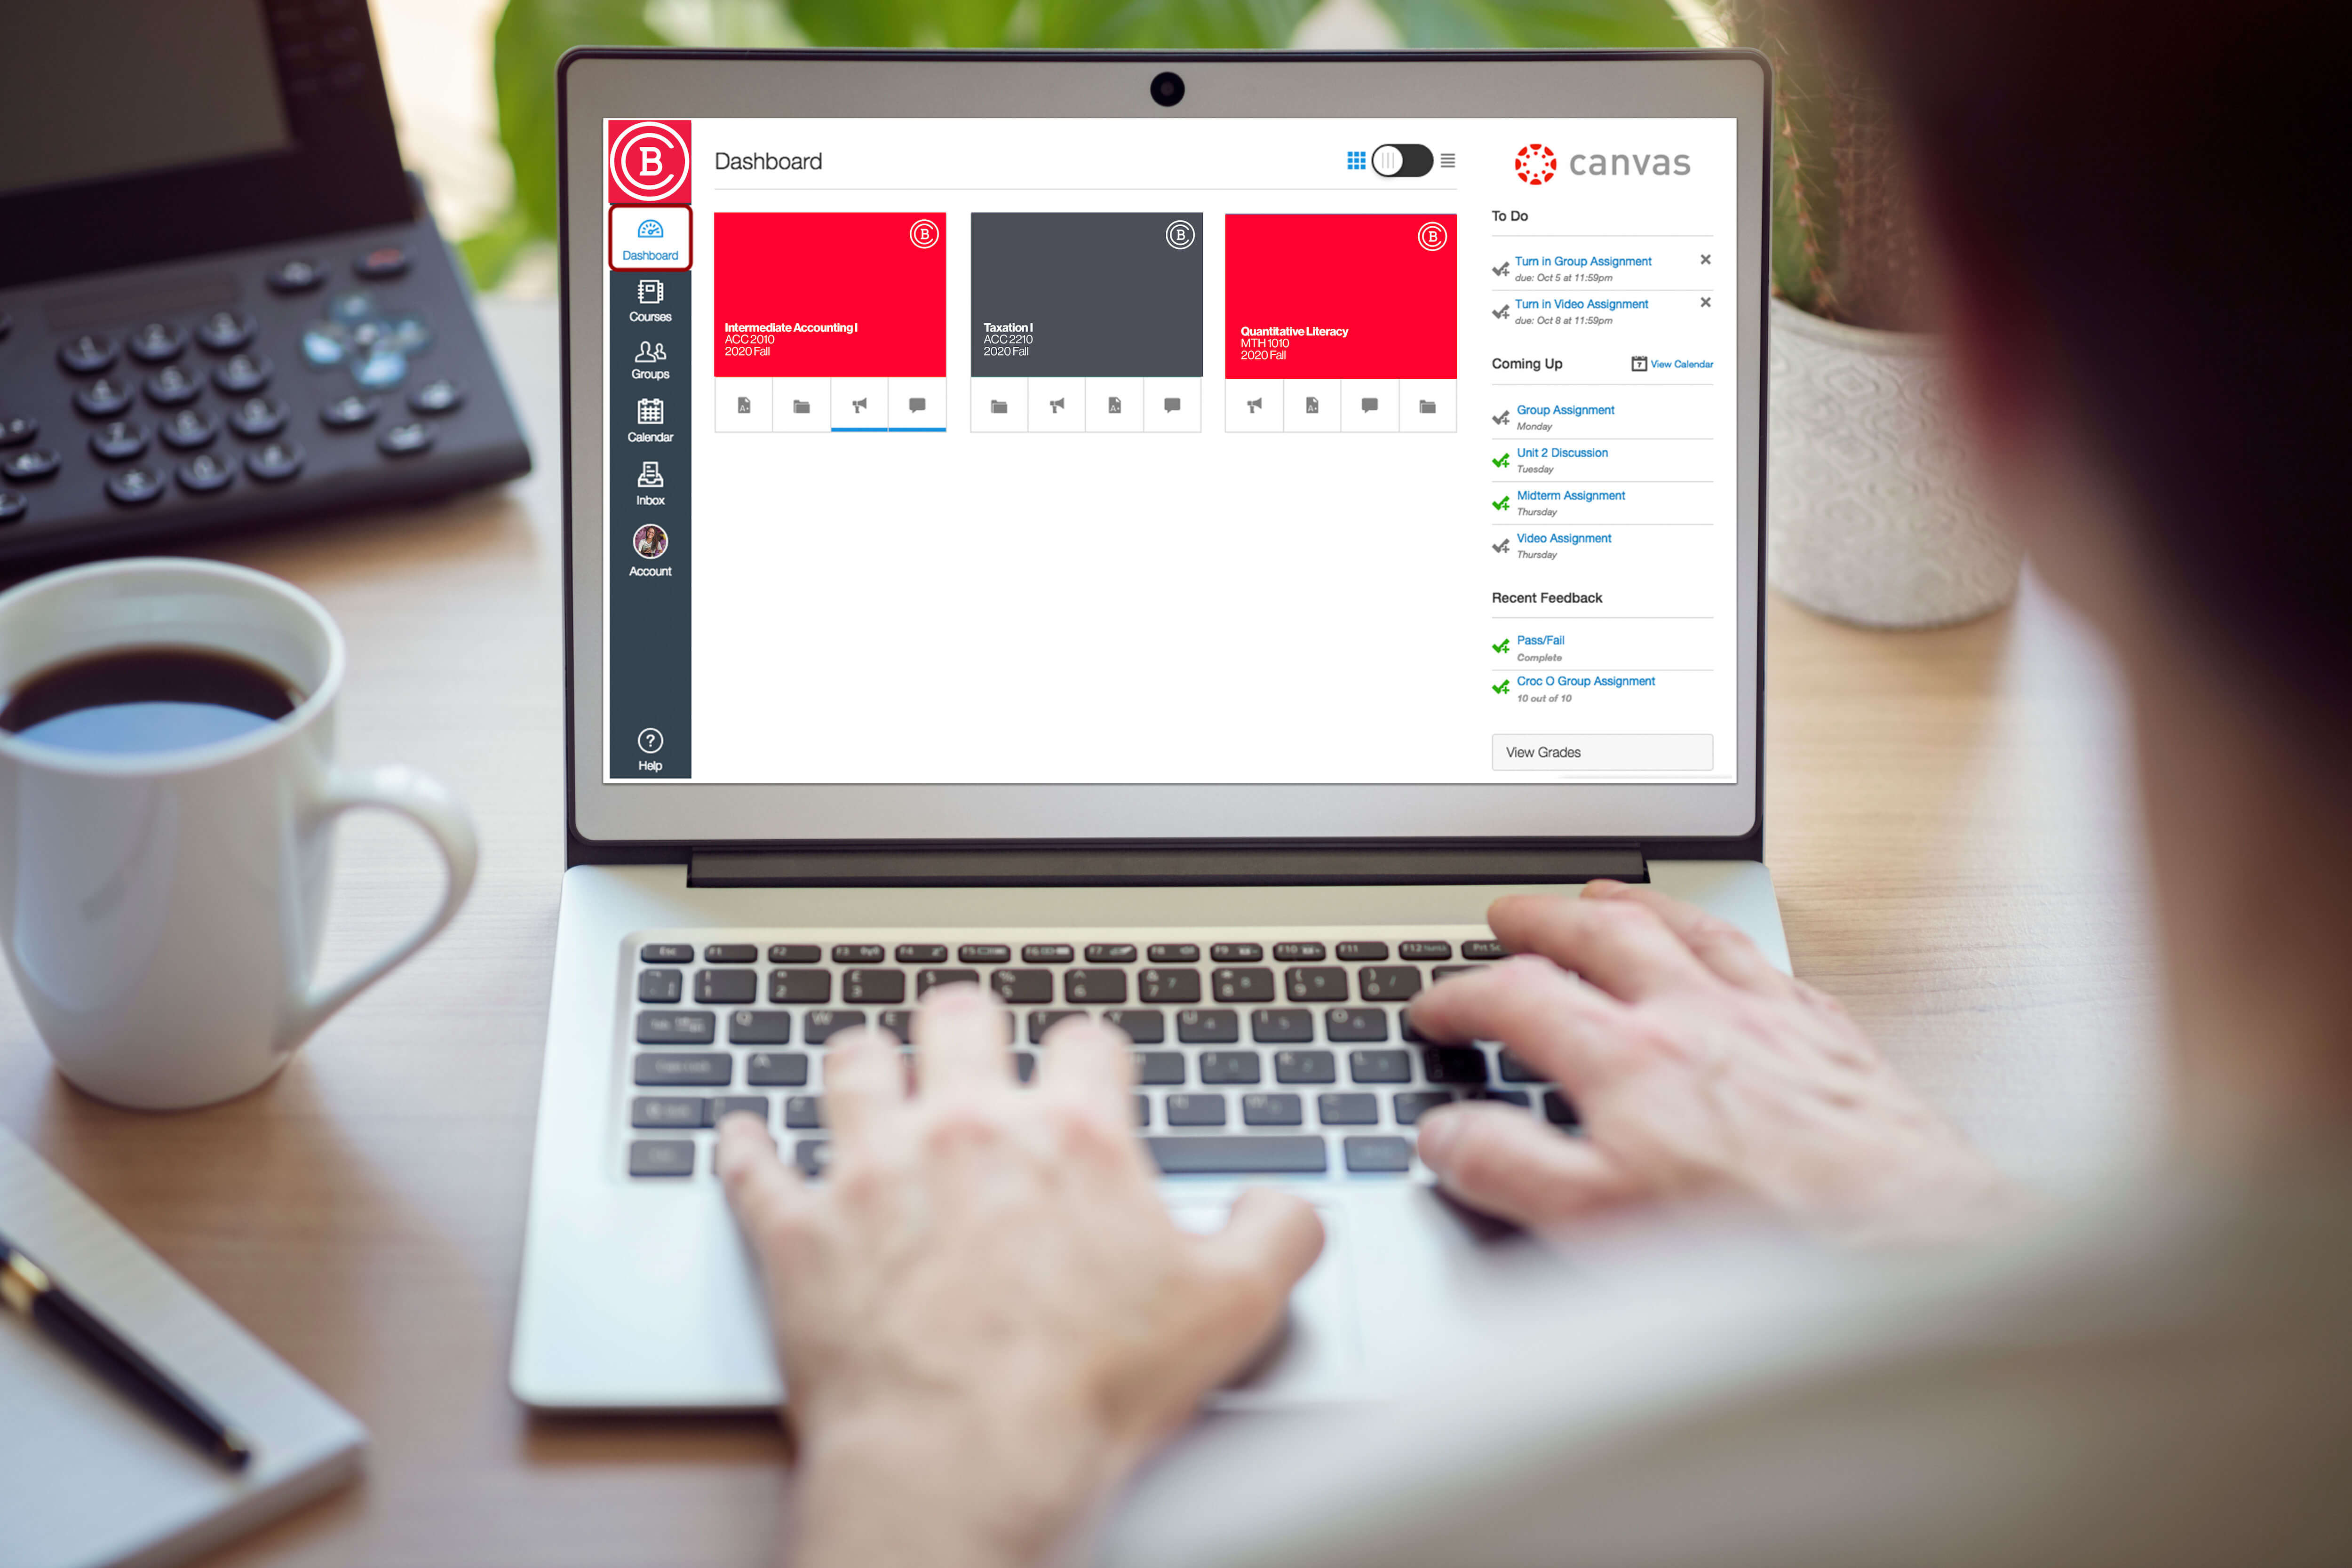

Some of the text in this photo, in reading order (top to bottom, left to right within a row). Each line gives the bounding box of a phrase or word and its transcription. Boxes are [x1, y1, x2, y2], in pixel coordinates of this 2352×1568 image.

[715, 152, 822, 170] Dashboard
[1570, 154, 1691, 175] canvas
[1491, 210, 1528, 222] To Do
[623, 250, 679, 260] Dashboard
[1515, 256, 1653, 269] Turn in Group Assignment
[1515, 273, 1534, 282] due:
[1537, 273, 1553, 282] Oct
[1555, 273, 1561, 282] 5
[1575, 273, 1613, 283] 11:59pm
[1515, 299, 1649, 311] Turn in Video Assignment
[629, 311, 673, 322] Courses
[1515, 316, 1534, 325] due:
[1537, 316, 1553, 325] Oct
[1555, 316, 1561, 325] 8
[1575, 316, 1613, 326] 11:59pm
[725, 322, 858, 334] Intermediate Accounting I
[983, 322, 1033, 333] Taxation I
[1240, 326, 1349, 338] Quantitative Literacy
[724, 334, 775, 344] ACC 2010
[983, 334, 1033, 345] ACC 2210
[1241, 338, 1290, 348] MTH 1010
[724, 346, 770, 357] 2020 Fall
[984, 346, 1029, 357] 2020 Fall
[1240, 350, 1286, 360] 2020 Fall
[1492, 358, 1563, 372] Coming Up
[1651, 359, 1714, 368] View Calendar
[631, 368, 670, 382] Groups
[1517, 405, 1615, 417] Group Assignment
[1517, 422, 1553, 432] Monday
[628, 431, 674, 443] Calendar
[1517, 447, 1609, 458] Unit 2 Discussion
[1518, 464, 1554, 475] Tuesday
[636, 495, 666, 506] Inbox
[1518, 490, 1626, 503] Midterm Assignment
[1518, 507, 1558, 518] Thursday
[1517, 533, 1612, 546] Video Assignment
[1518, 550, 1558, 561] Thursday
[628, 566, 673, 577] Account
[1492, 592, 1603, 604] Recent Feedback
[1518, 635, 1565, 645] Pass/Fail
[1517, 653, 1562, 663] Complete
[1517, 676, 1656, 689] Croc O Group Assignment
[1518, 694, 1529, 702] 10
[1548, 694, 1559, 702] of
[1561, 694, 1572, 702] 10
[1506, 746, 1581, 758] View Grades
[638, 760, 663, 773] Help
[660, 947, 677, 955] Esc
[709, 947, 722, 955] F1
[774, 947, 787, 956] F2
[836, 947, 850, 955] F3
[900, 946, 914, 955] F4
[963, 947, 976, 955] F5
[1025, 946, 1040, 955] F6
[1089, 946, 1103, 955] F7
[1215, 945, 1229, 954] F9
[1278, 945, 1298, 954] F10
[1341, 944, 1358, 953] F11
[1403, 944, 1422, 952] F12
[1168, 977, 1176, 989] 7
[1314, 976, 1325, 987] 9
[776, 985, 787, 998] 2
[851, 985, 862, 997] 3
[1001, 985, 1013, 998] 5
[1074, 984, 1087, 997] 6
[1149, 984, 1159, 997] 7
[1222, 984, 1234, 997] 8
[1295, 983, 1307, 996] 9
[812, 1012, 833, 1026] W
